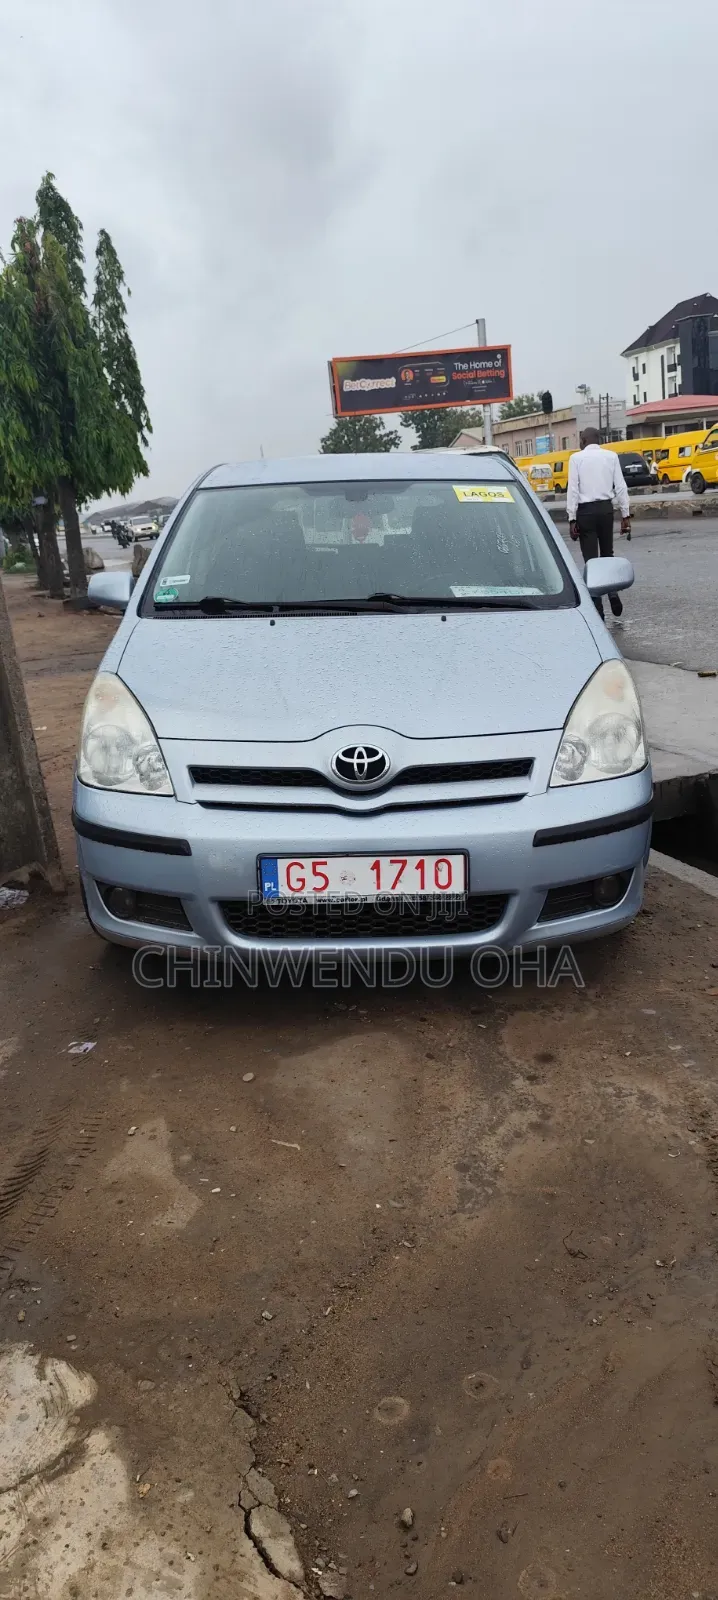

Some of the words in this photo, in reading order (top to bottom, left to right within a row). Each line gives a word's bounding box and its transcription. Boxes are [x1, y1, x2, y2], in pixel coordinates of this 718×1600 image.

[454, 362, 468, 370] The
[469, 360, 493, 369] Home
[494, 359, 502, 367] of
[451, 370, 477, 380] Social
[477, 368, 505, 379] Betting
[285, 860, 330, 892] G5
[370, 857, 453, 891] 1710
[264, 882, 277, 891] PL
